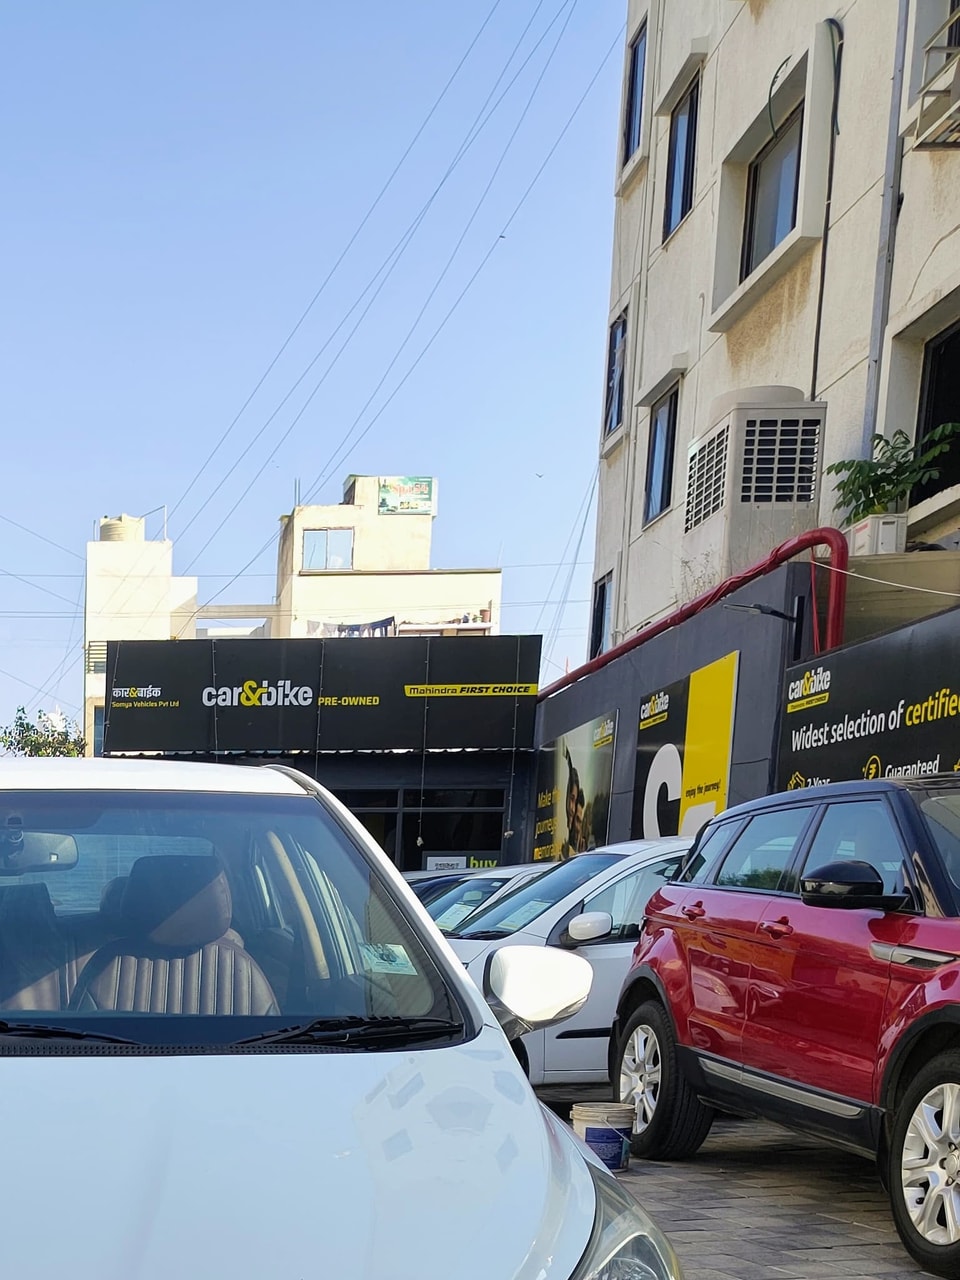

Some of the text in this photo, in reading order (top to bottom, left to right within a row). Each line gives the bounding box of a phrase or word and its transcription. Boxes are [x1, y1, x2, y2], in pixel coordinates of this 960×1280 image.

[202, 680, 380, 706] car&bike PRE-OWNED
[410, 687, 457, 695] Mahindra
[459, 686, 490, 694] FIRST
[789, 667, 831, 700] car&bike
[641, 692, 669, 719] car&bike
[792, 688, 960, 752] Widest selection of certifie
[885, 754, 940, 778] Guaranteed
